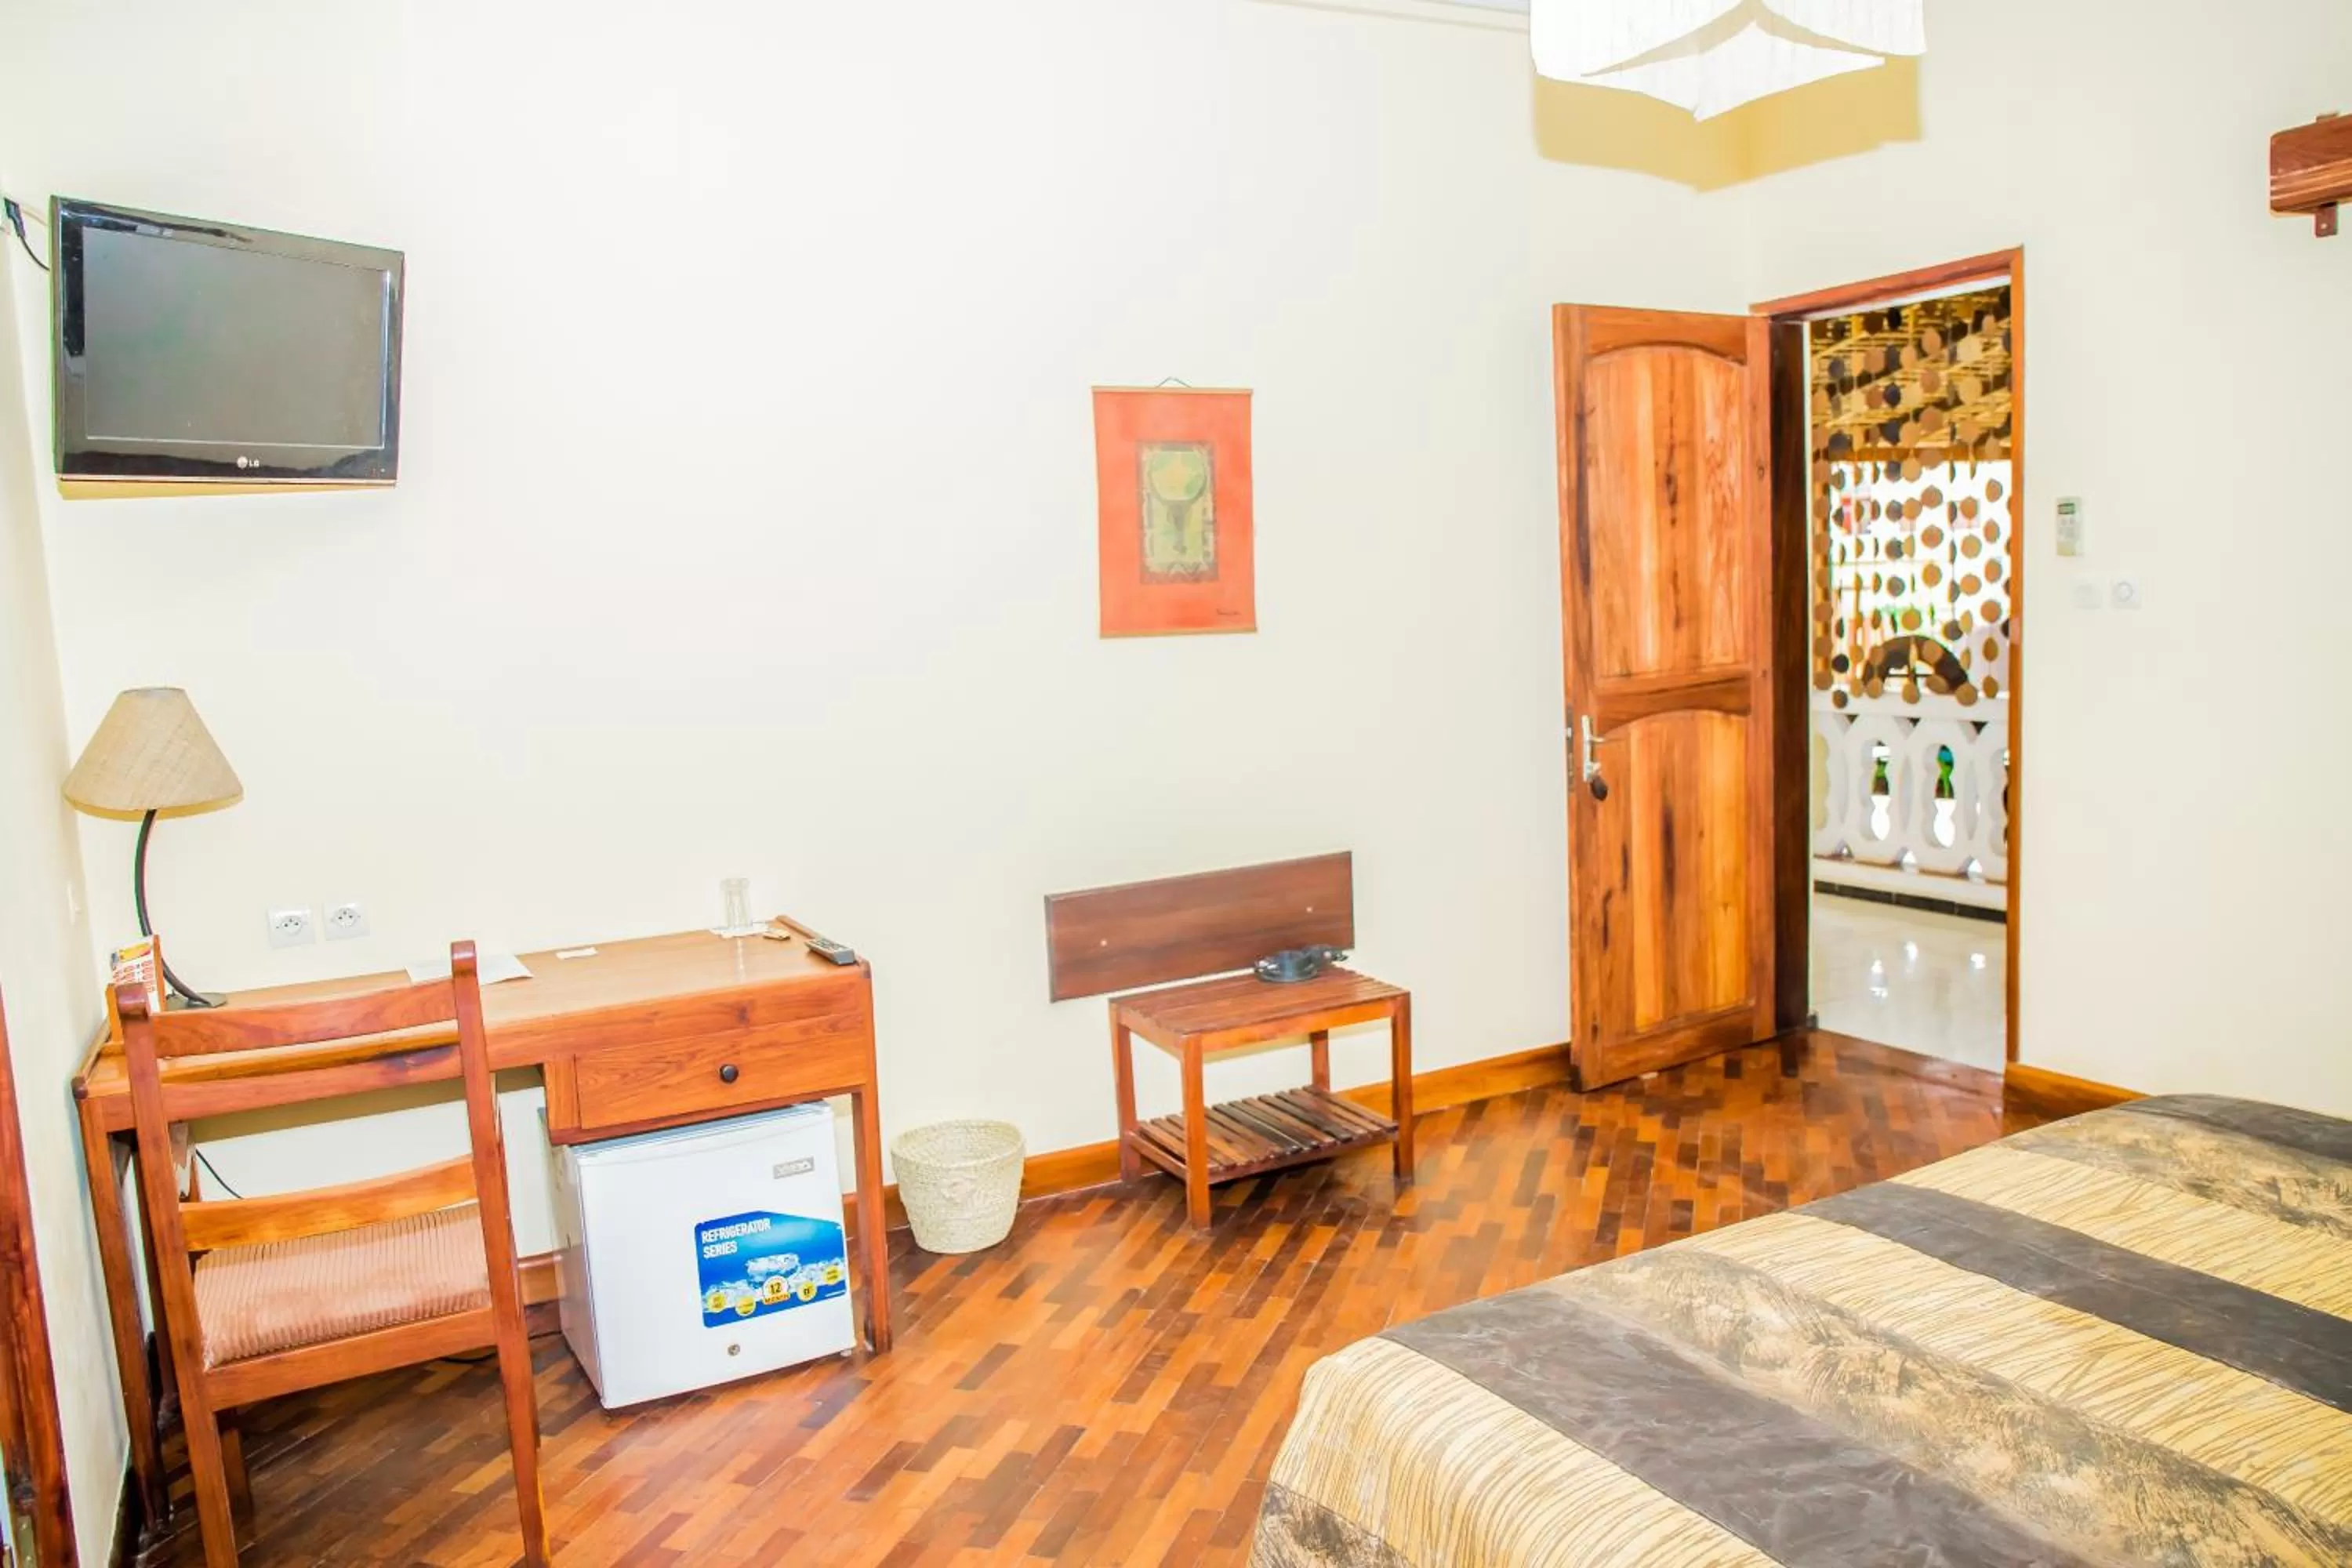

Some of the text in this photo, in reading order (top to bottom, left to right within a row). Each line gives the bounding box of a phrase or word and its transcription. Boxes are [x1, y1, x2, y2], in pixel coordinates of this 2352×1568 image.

[702, 1218, 771, 1244] REFRIGERATOR
[703, 1240, 738, 1258] SERIES
[771, 1282, 782, 1294] 12
